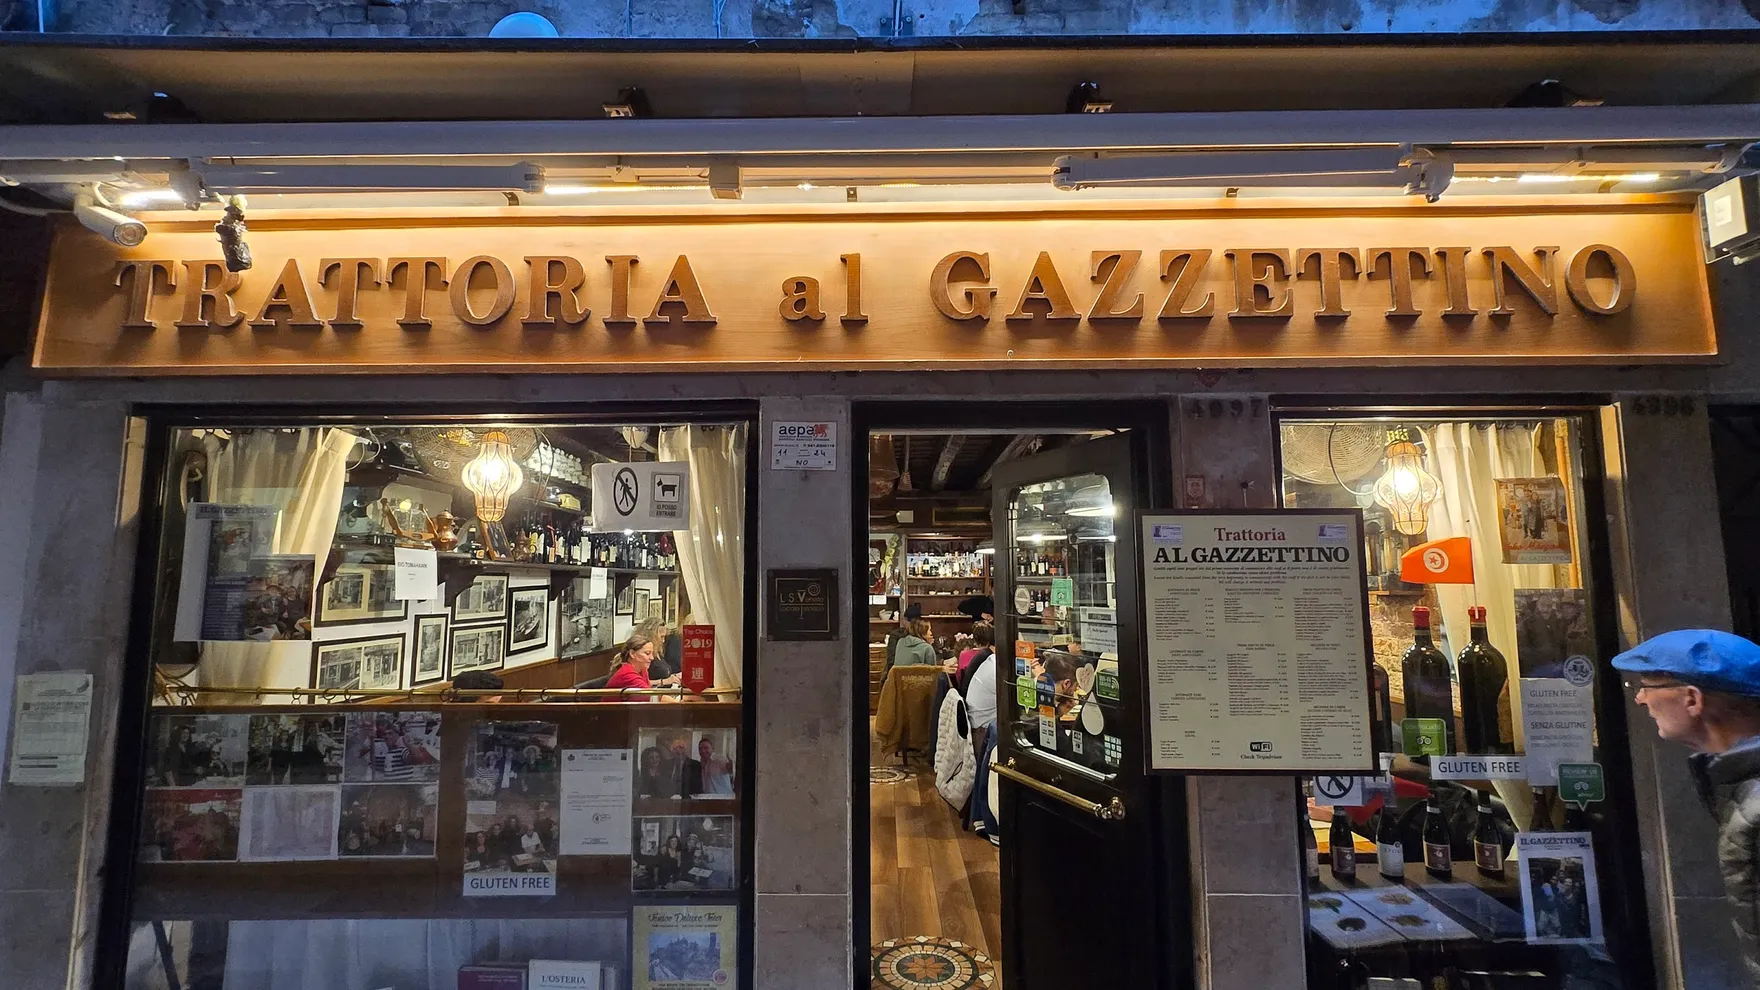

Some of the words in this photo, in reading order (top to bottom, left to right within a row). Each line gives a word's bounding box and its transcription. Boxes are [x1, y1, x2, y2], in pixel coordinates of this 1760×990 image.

[114, 254, 719, 328] TRATTORIA
[779, 253, 870, 323] al
[929, 244, 1638, 322] GAZZETTINO
[1213, 527, 1286, 541] Trattoria
[1191, 546, 1350, 563] GAZZETTINO
[1530, 690, 1559, 698] GLUTEN
[1555, 721, 1587, 729] GLUTINE
[1438, 761, 1487, 773] GLUTEN
[1491, 761, 1520, 773] FREE
[1530, 837, 1586, 845] GAZZETTINO
[470, 878, 518, 889] GLUTEN
[522, 877, 550, 888] FREE
[541, 975, 586, 984] L'OSTERIA
